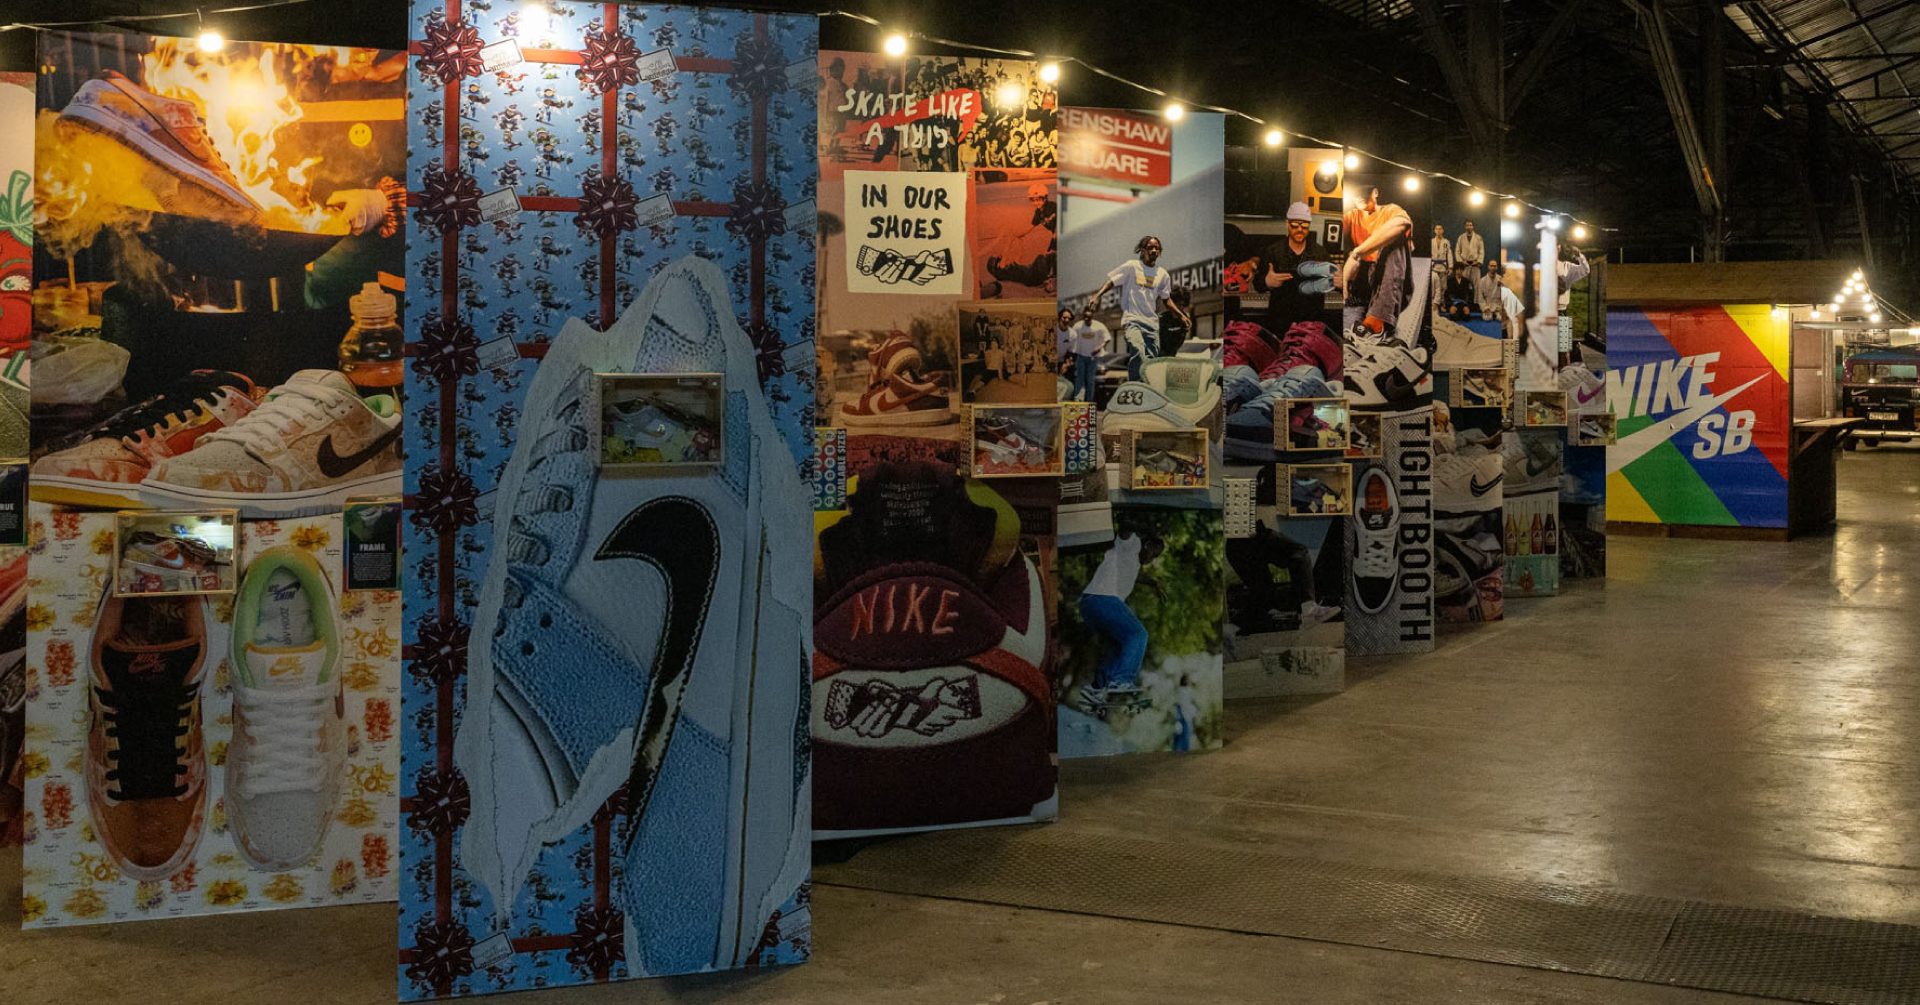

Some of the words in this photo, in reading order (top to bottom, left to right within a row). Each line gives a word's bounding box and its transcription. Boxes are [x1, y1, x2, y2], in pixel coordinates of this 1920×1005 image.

[837, 88, 918, 117] SKATE
[928, 92, 973, 120] LIKE
[865, 122, 884, 146] A
[1057, 143, 1149, 176] SQUARE
[861, 184, 887, 209] IN
[904, 185, 950, 212] OUR
[866, 215, 942, 240] SHOES
[1605, 351, 1720, 420] NIKE
[838, 429, 846, 455] SIZES
[1693, 409, 1756, 460] SB
[838, 456, 846, 506] AVAILABLE
[1399, 417, 1431, 641] TIGHTBOOTH
[359, 543, 387, 551] FRAME
[851, 583, 960, 640] NIKE
